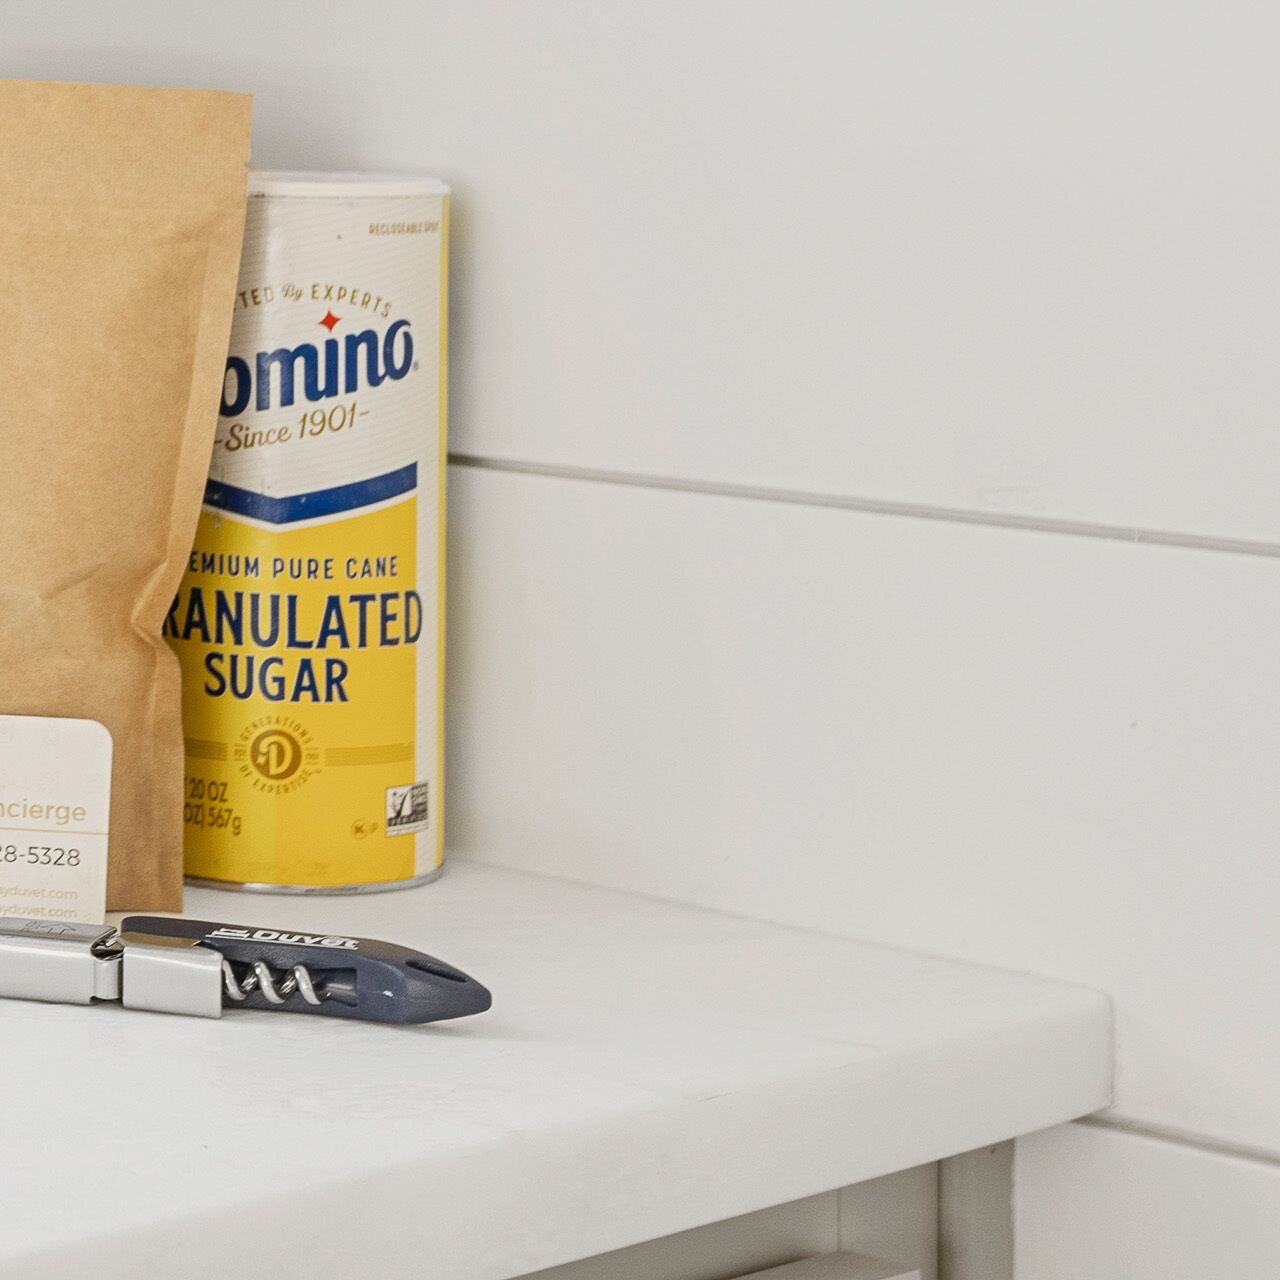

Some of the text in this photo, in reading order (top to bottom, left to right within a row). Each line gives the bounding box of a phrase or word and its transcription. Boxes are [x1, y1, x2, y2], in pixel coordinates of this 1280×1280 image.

[234, 287, 275, 313] TED
[311, 284, 392, 318] EXPERTS
[218, 319, 413, 418] omino
[190, 550, 398, 580] EMIUM PURE CANE
[162, 585, 424, 650] RANULATED
[203, 652, 350, 703] SUGAR
